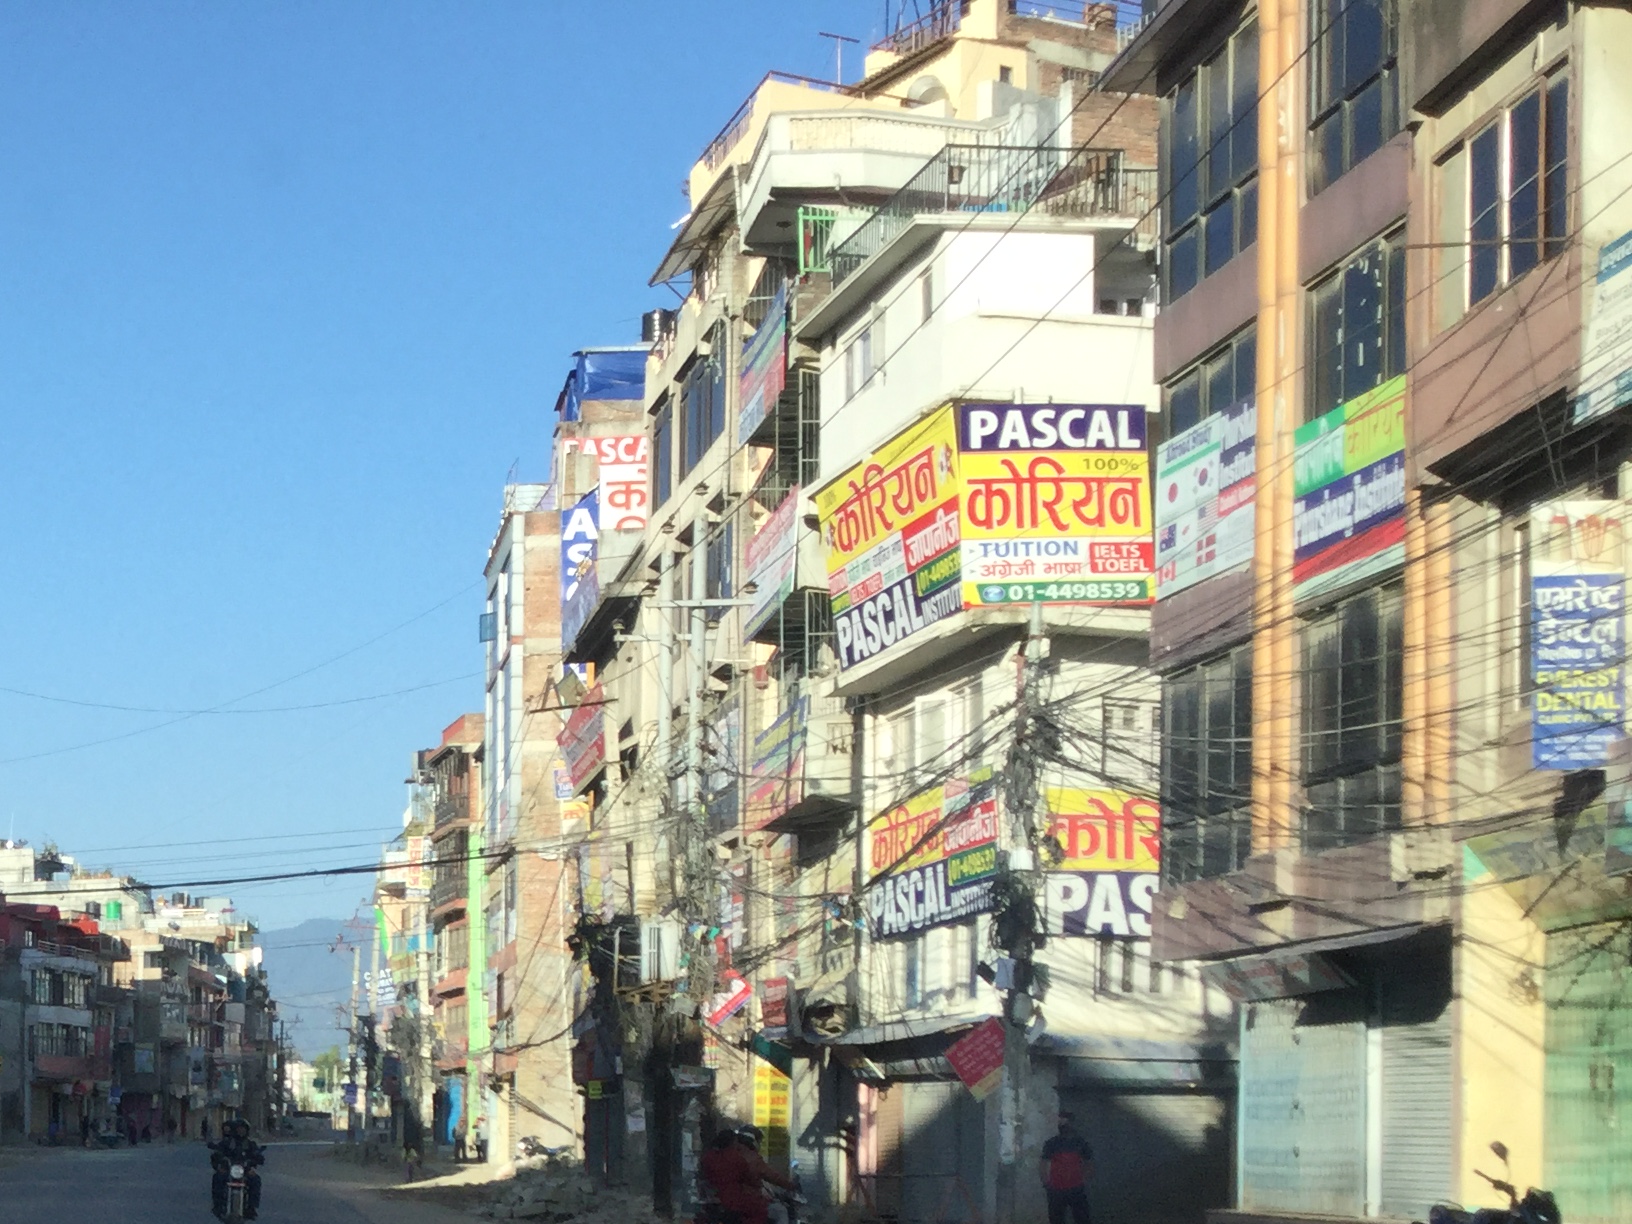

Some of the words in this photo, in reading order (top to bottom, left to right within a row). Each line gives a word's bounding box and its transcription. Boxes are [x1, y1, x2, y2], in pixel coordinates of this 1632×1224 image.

[969, 409, 1141, 449] PASCAL
[1082, 458, 1139, 472] 100%
[834, 445, 937, 553] कोरियन
[967, 456, 1142, 532] कोरियन
[978, 540, 1079, 558] TUITION
[1094, 545, 1140, 558] IELTS
[980, 559, 1036, 579] अंग्रेजी
[1043, 562, 1082, 575] भाषा
[1094, 558, 1149, 572] TOEFL
[1008, 583, 1140, 600] 01-4498539
[836, 578, 924, 668] PASCAL
[1536, 691, 1621, 712] DENTAL
[871, 863, 951, 934] PASCAL
